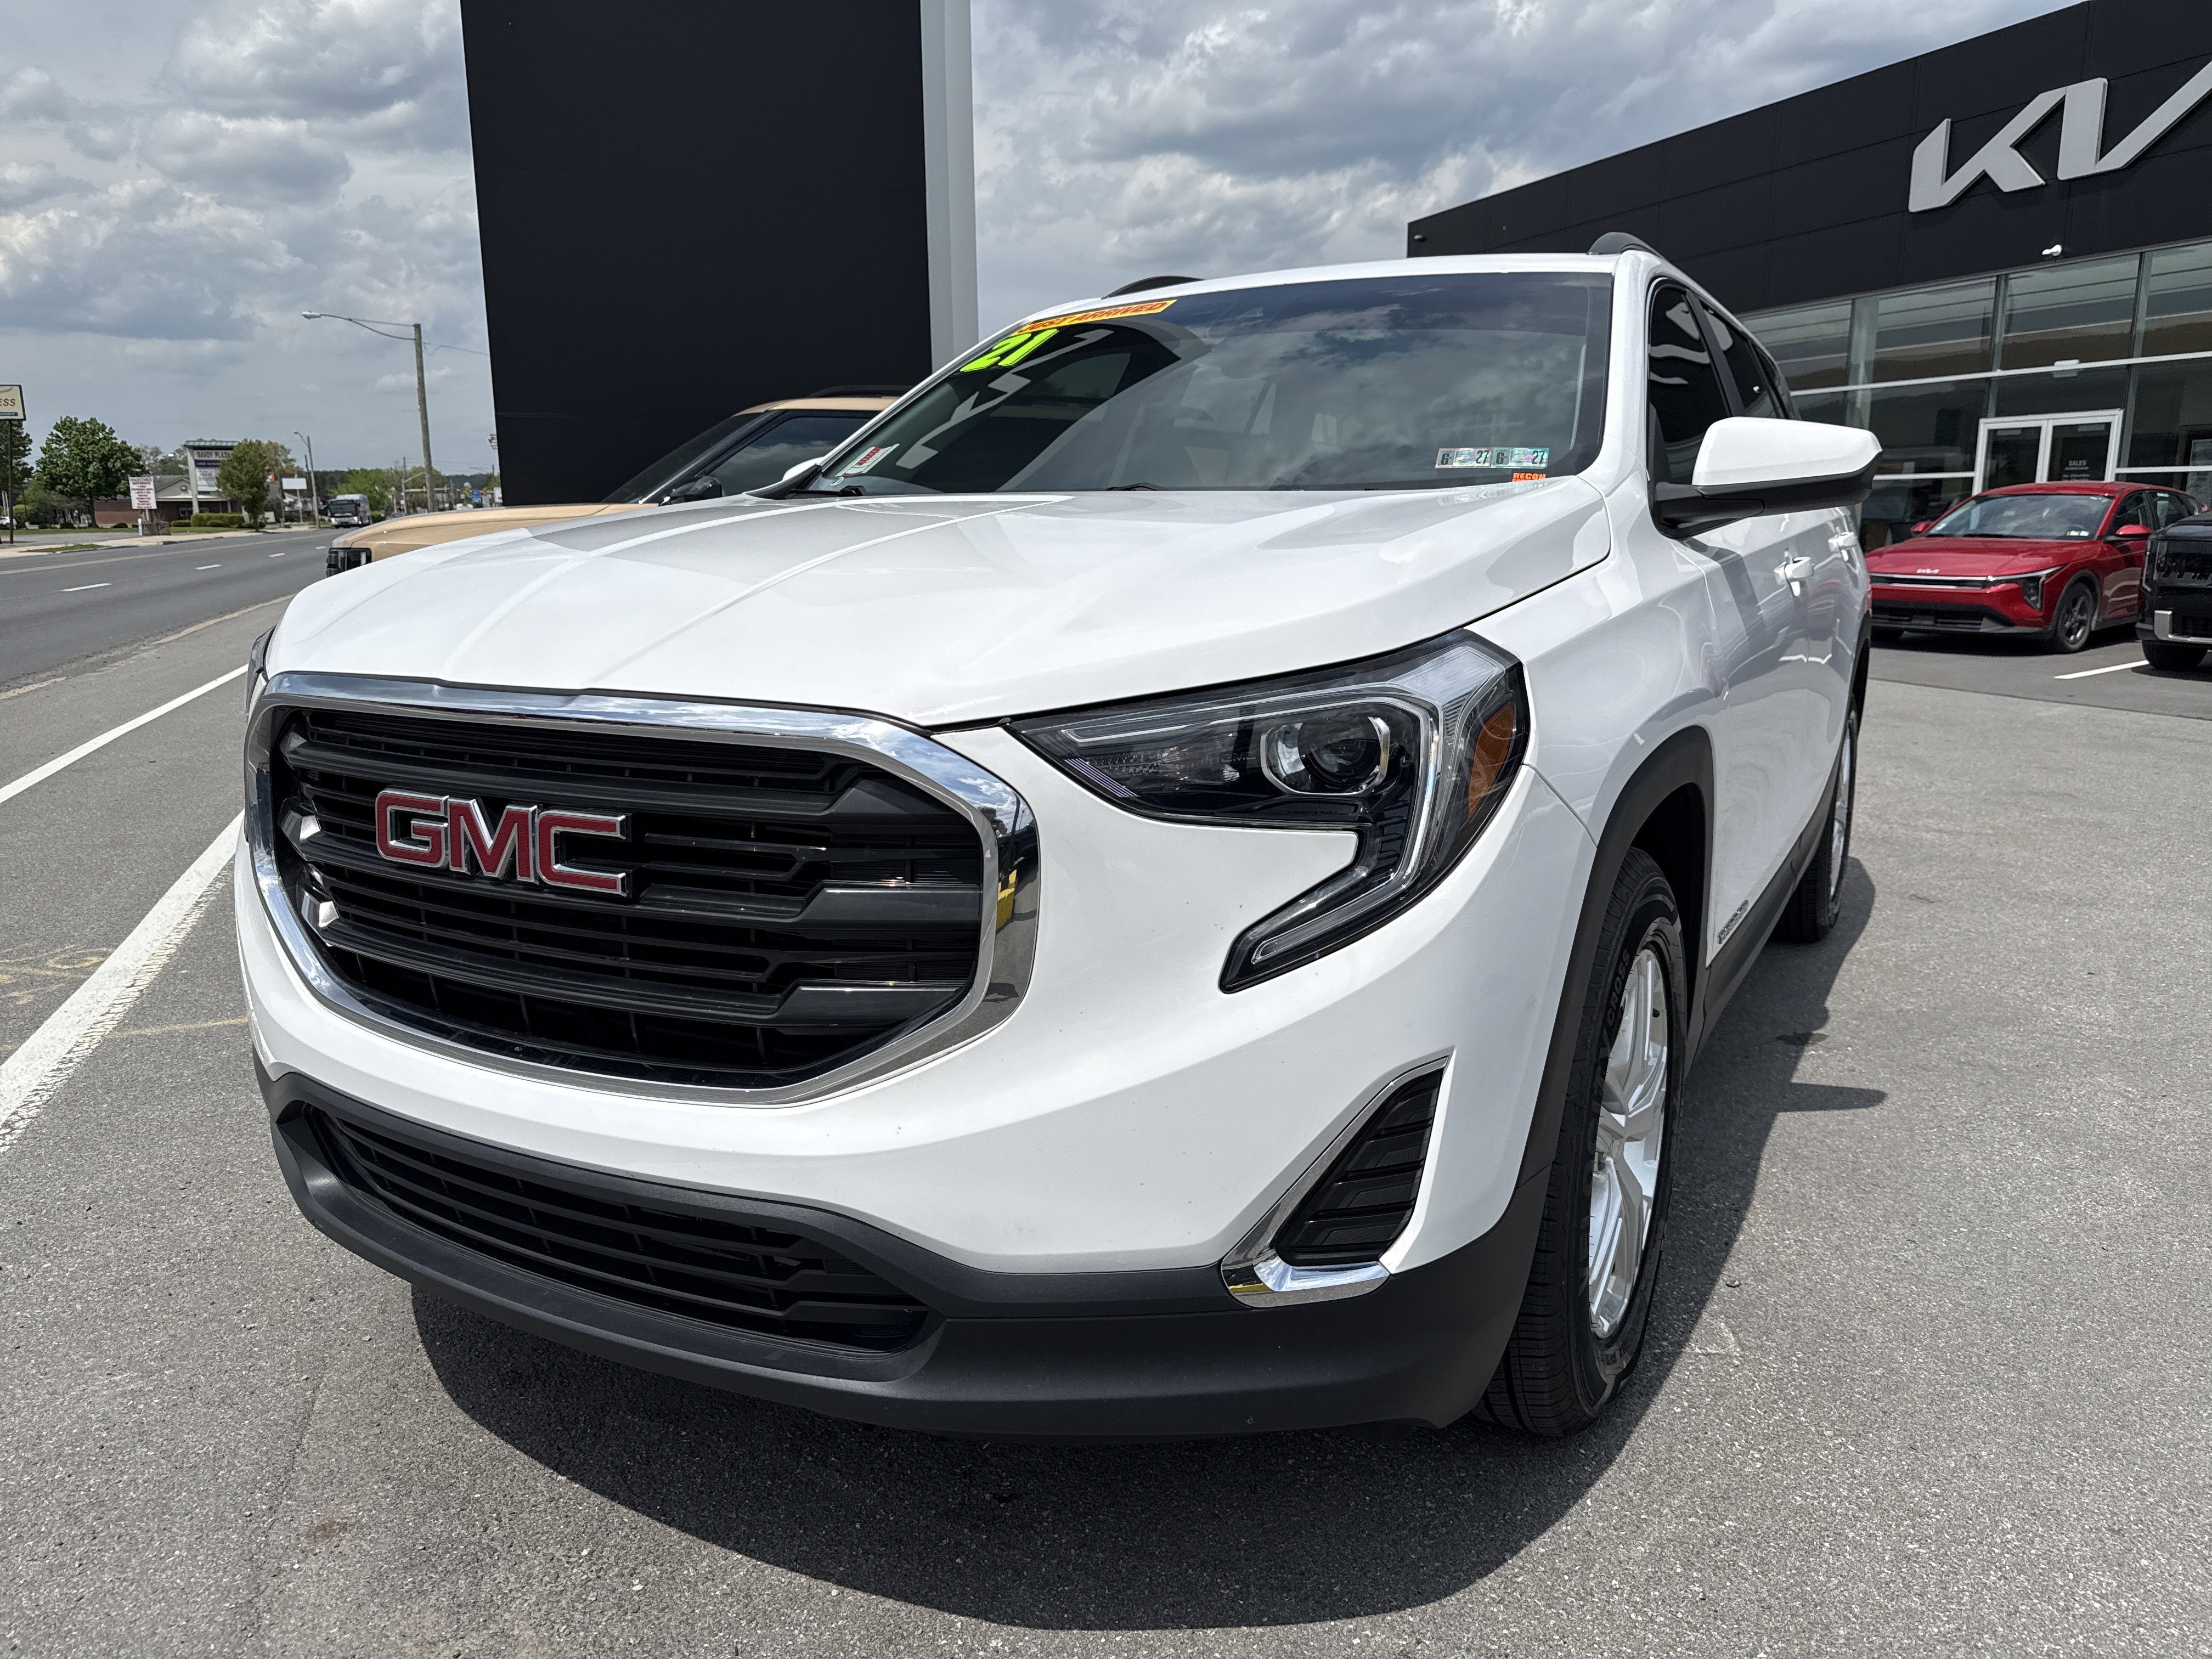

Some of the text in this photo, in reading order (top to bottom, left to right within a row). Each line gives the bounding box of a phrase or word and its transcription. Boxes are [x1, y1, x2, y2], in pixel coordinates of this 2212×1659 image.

[1018, 302, 1168, 334] JUST ARRIVED
[960, 329, 1059, 373] 21
[1476, 450, 1489, 465] 27
[1532, 450, 1545, 465] 27
[375, 786, 628, 897] GMC
[1607, 949, 1630, 1026] CROSS
